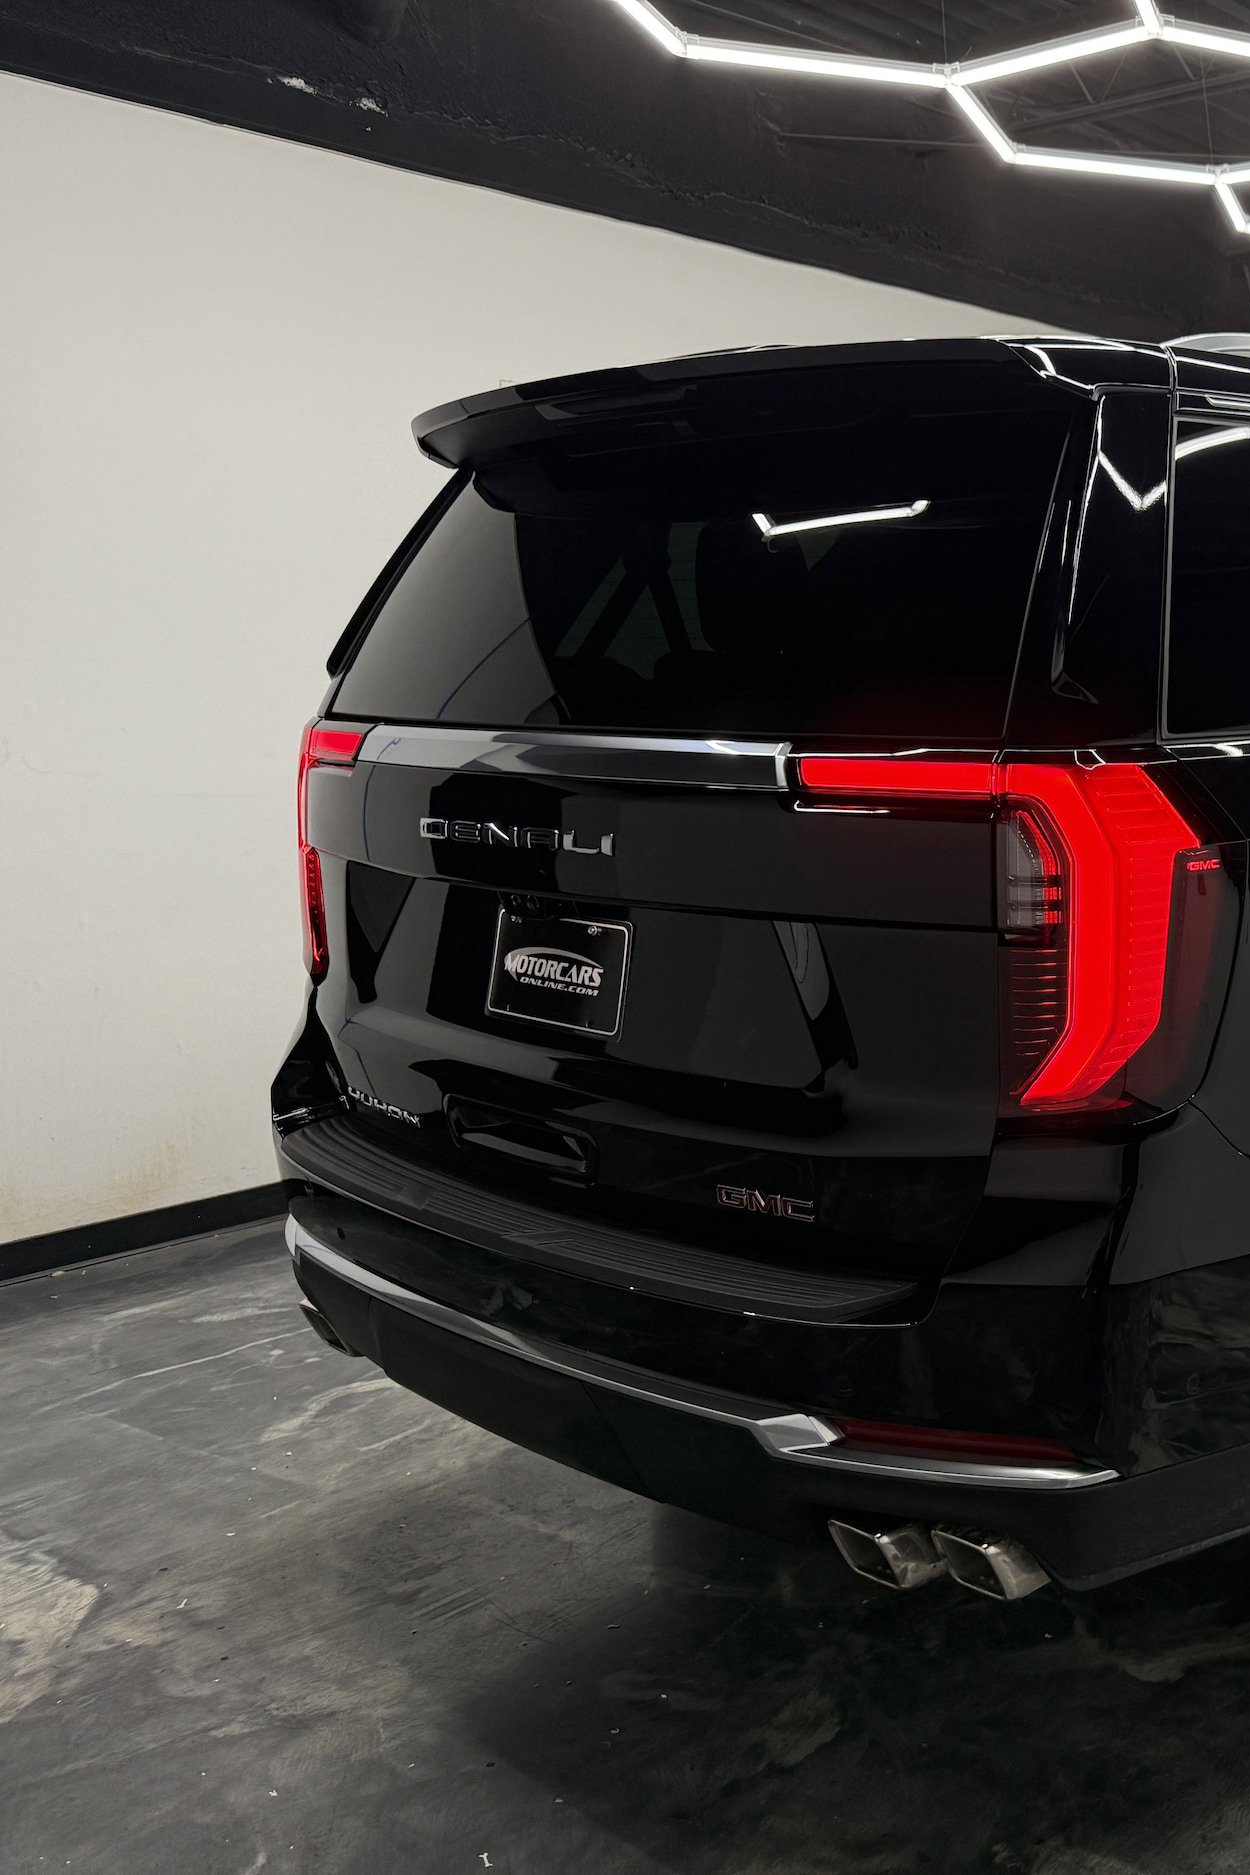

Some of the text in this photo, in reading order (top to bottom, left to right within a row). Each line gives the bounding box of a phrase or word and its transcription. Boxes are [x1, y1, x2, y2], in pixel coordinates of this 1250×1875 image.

[419, 817, 614, 856] DENALI
[1188, 858, 1220, 871] GMC
[504, 953, 604, 987] MOTORCARS
[520, 976, 599, 997] ONLINE.COM
[347, 1086, 421, 1129] YUKON
[716, 1184, 815, 1223] GMC
